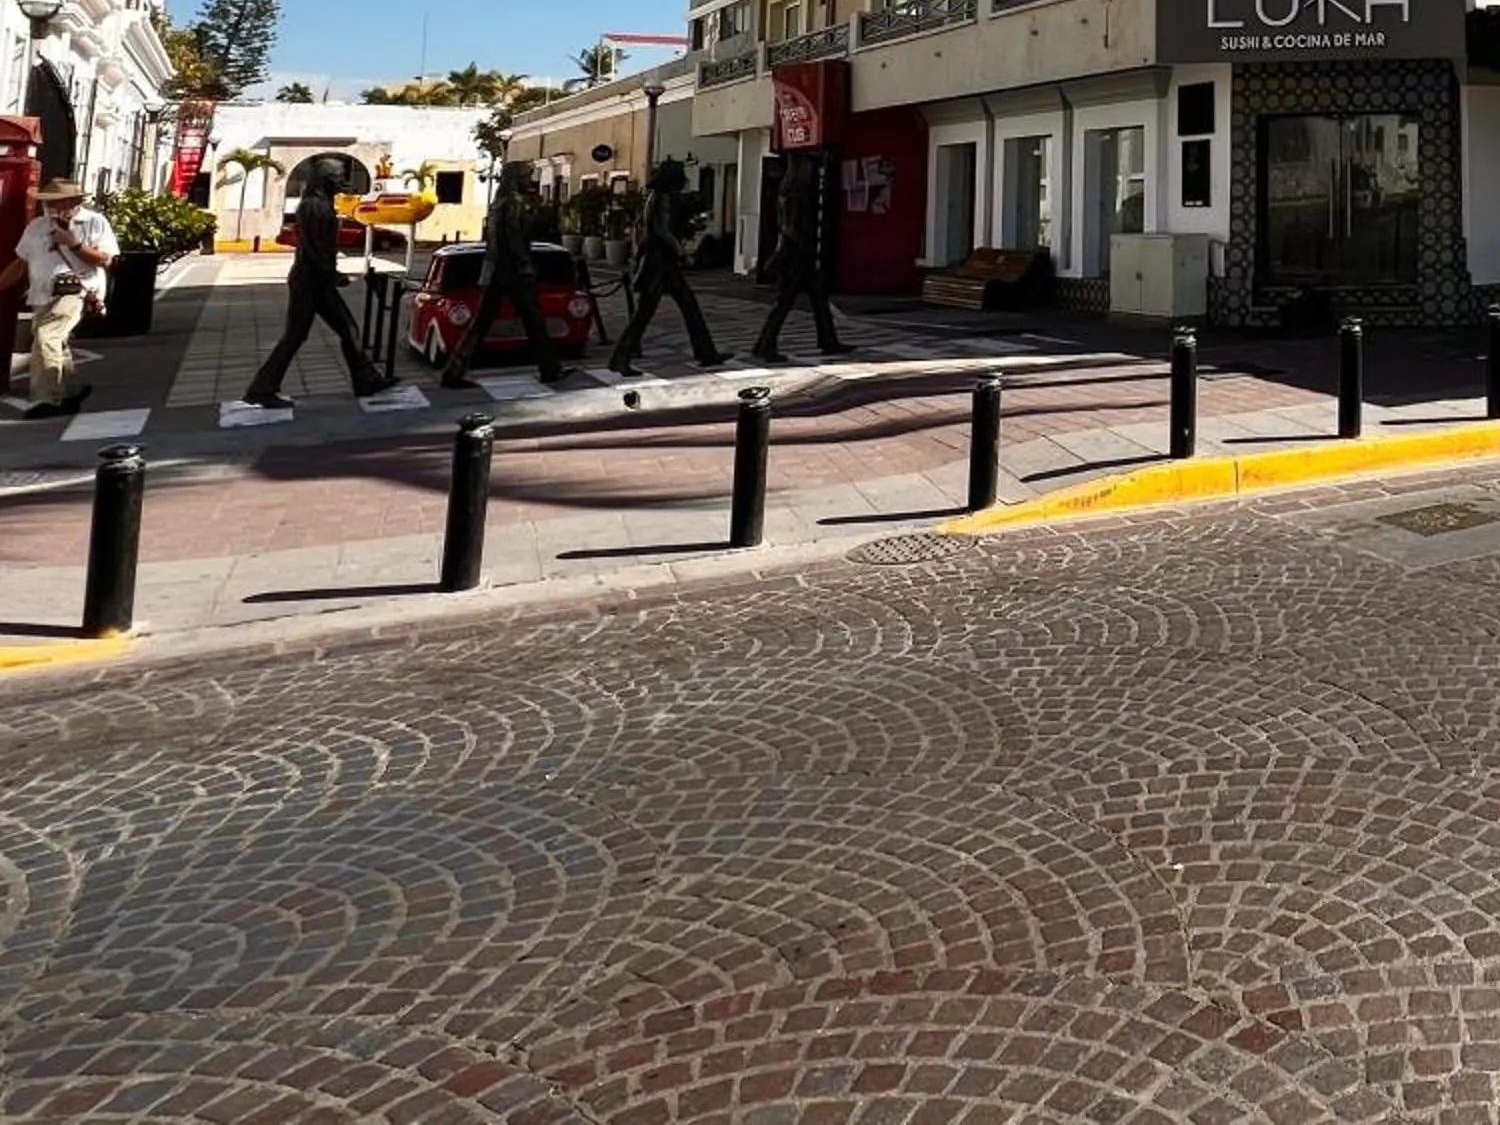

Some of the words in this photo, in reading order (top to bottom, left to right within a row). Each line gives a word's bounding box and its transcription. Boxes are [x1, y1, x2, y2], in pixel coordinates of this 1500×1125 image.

[1220, 36, 1260, 50] SUSHI
[1261, 36, 1273, 49] &
[1273, 34, 1331, 49] COCINA
[1333, 33, 1351, 47] DE
[1354, 32, 1386, 47] MAR
